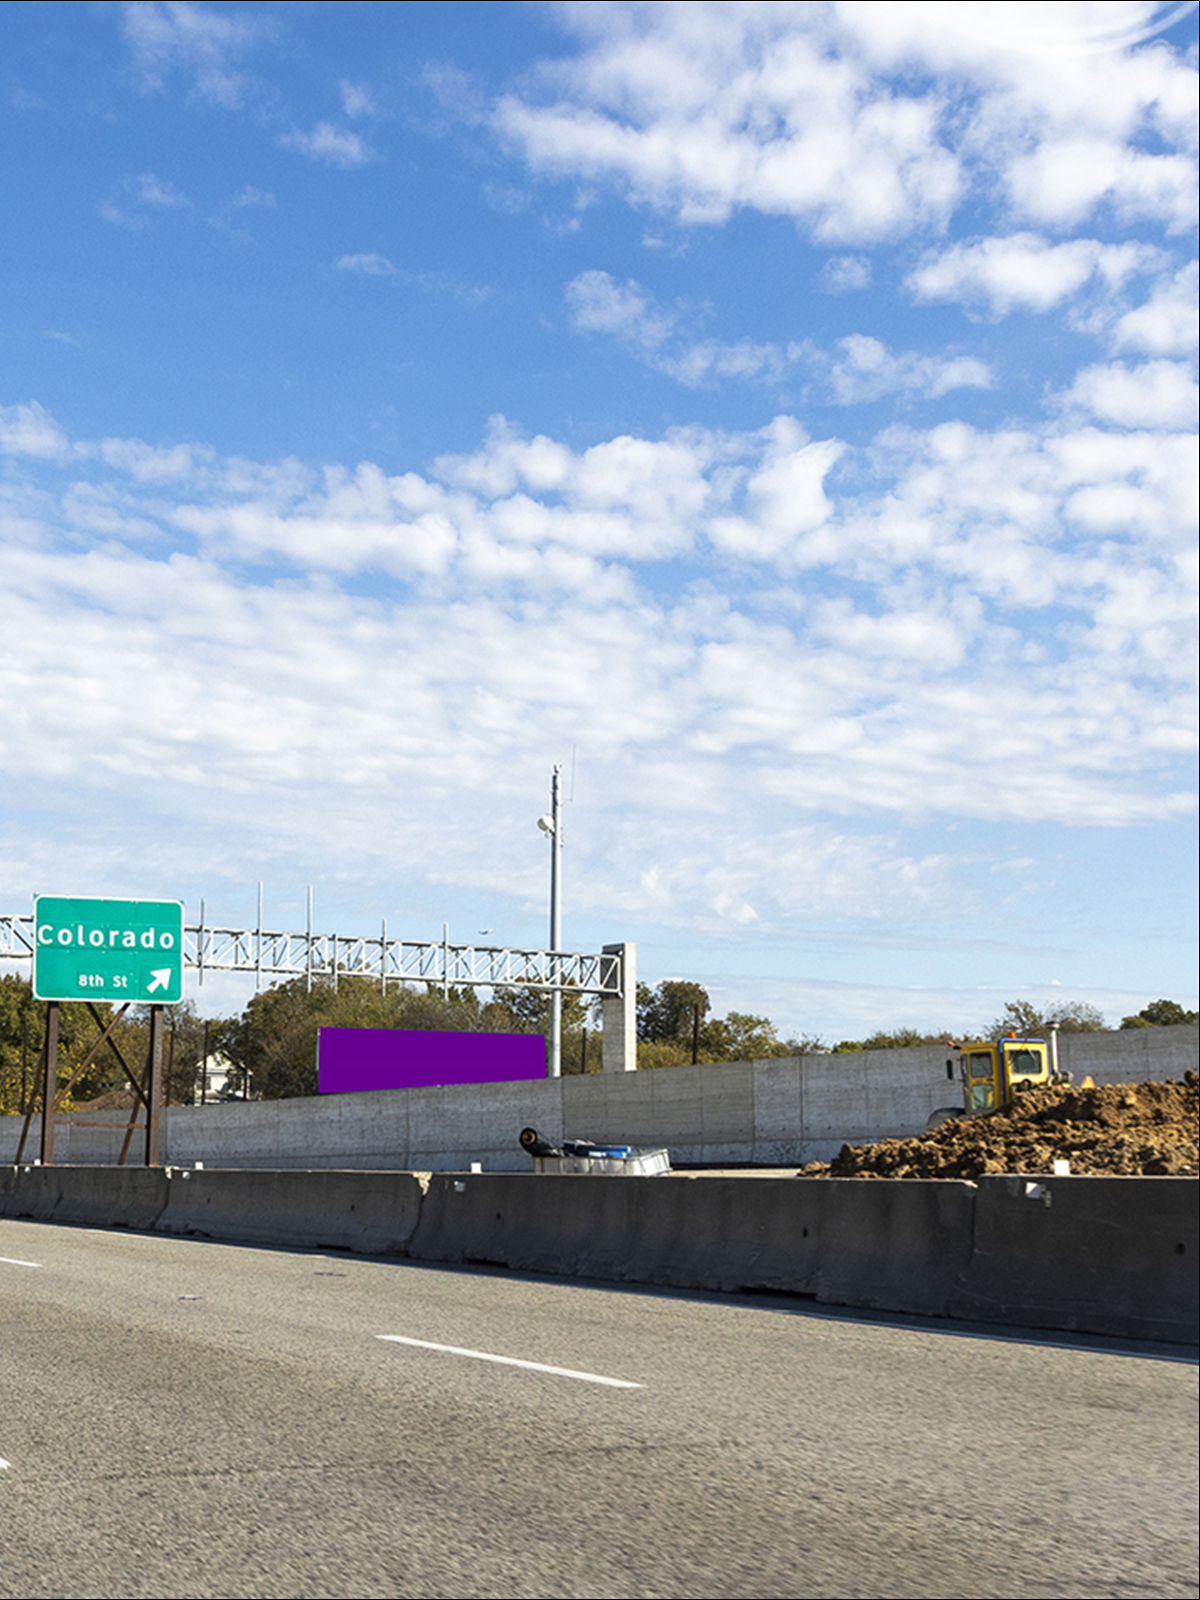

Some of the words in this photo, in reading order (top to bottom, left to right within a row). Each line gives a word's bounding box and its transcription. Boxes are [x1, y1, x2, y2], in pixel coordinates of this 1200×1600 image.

[38, 924, 174, 949] Colorado
[78, 974, 104, 987] 8th
[113, 975, 128, 988] St
